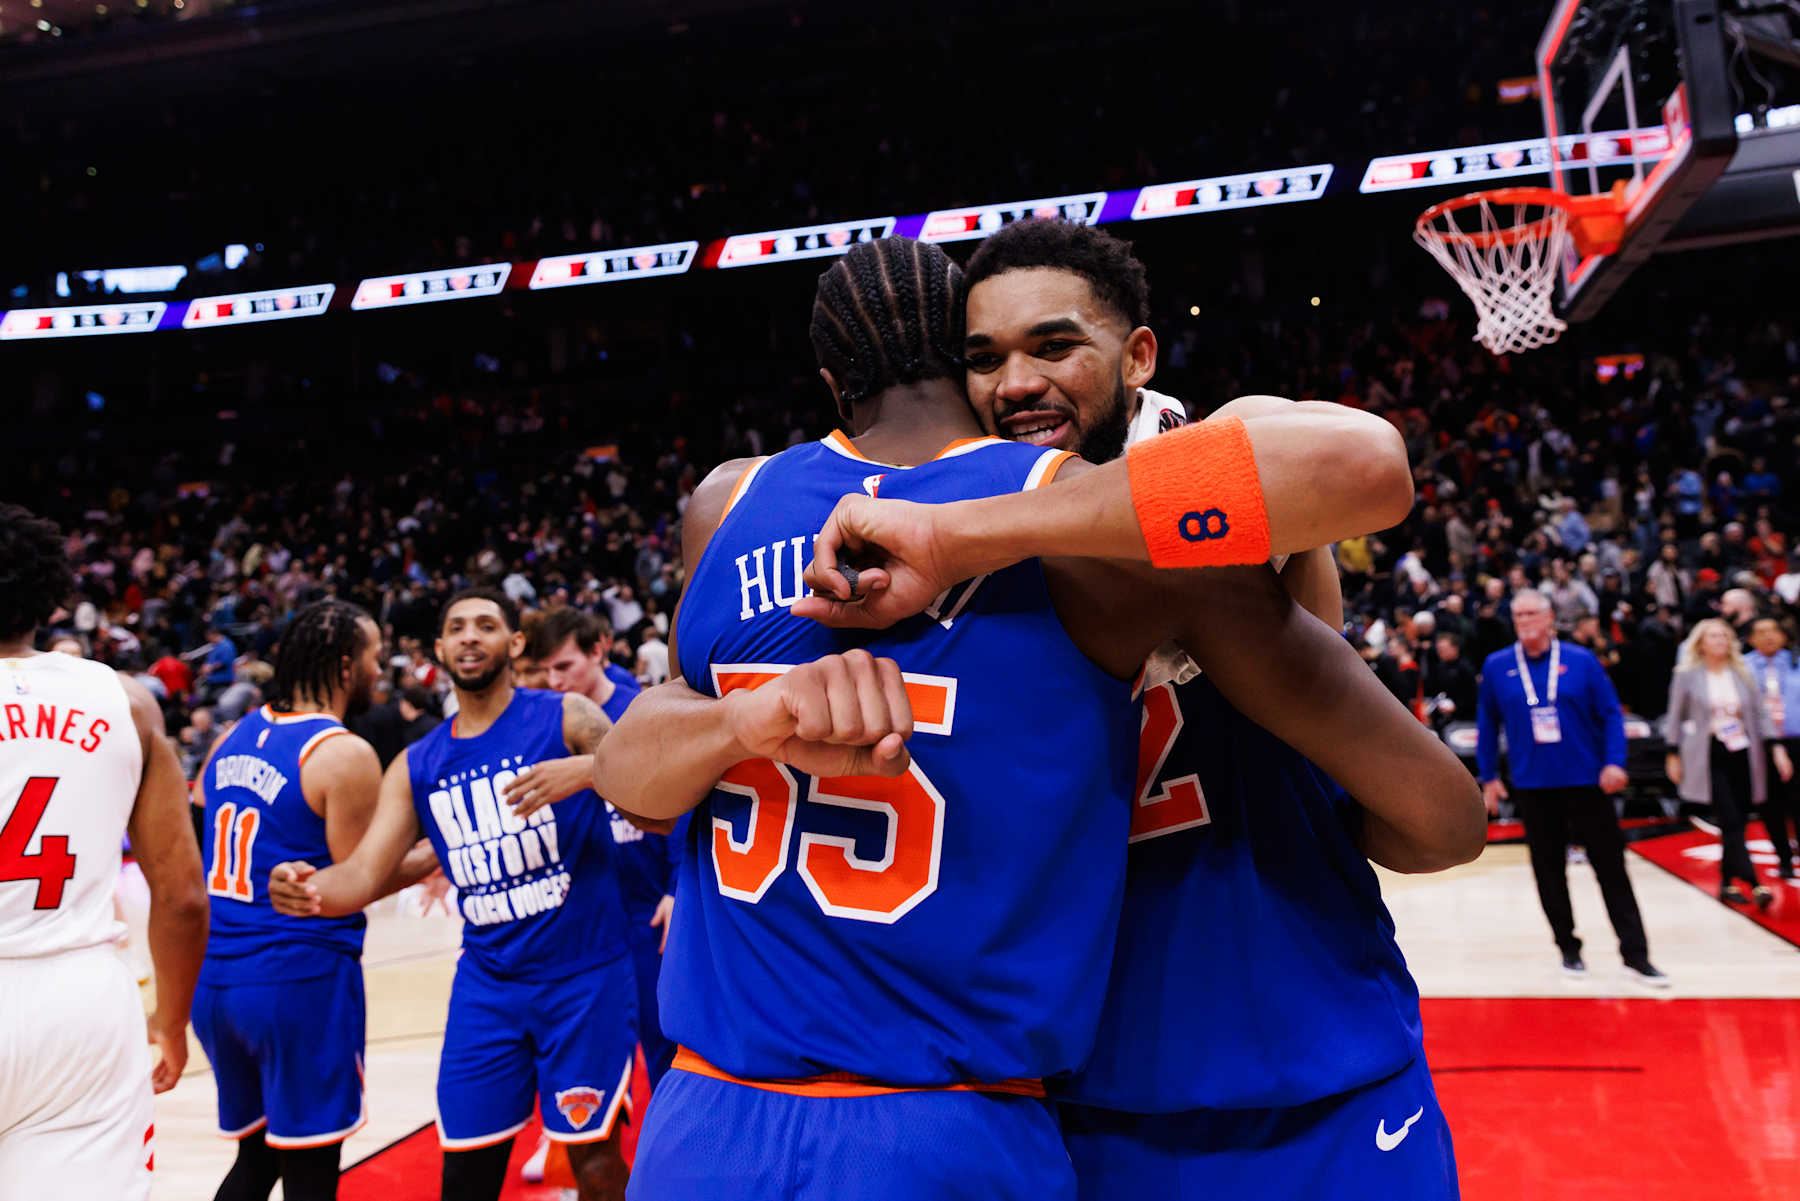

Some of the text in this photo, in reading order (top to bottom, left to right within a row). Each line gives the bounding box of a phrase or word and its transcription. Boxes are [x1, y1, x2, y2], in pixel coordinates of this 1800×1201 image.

[0, 703, 110, 753] RNES
[0, 776, 76, 910] 4
[207, 802, 260, 903] 11
[447, 821, 561, 888] HISTORY
